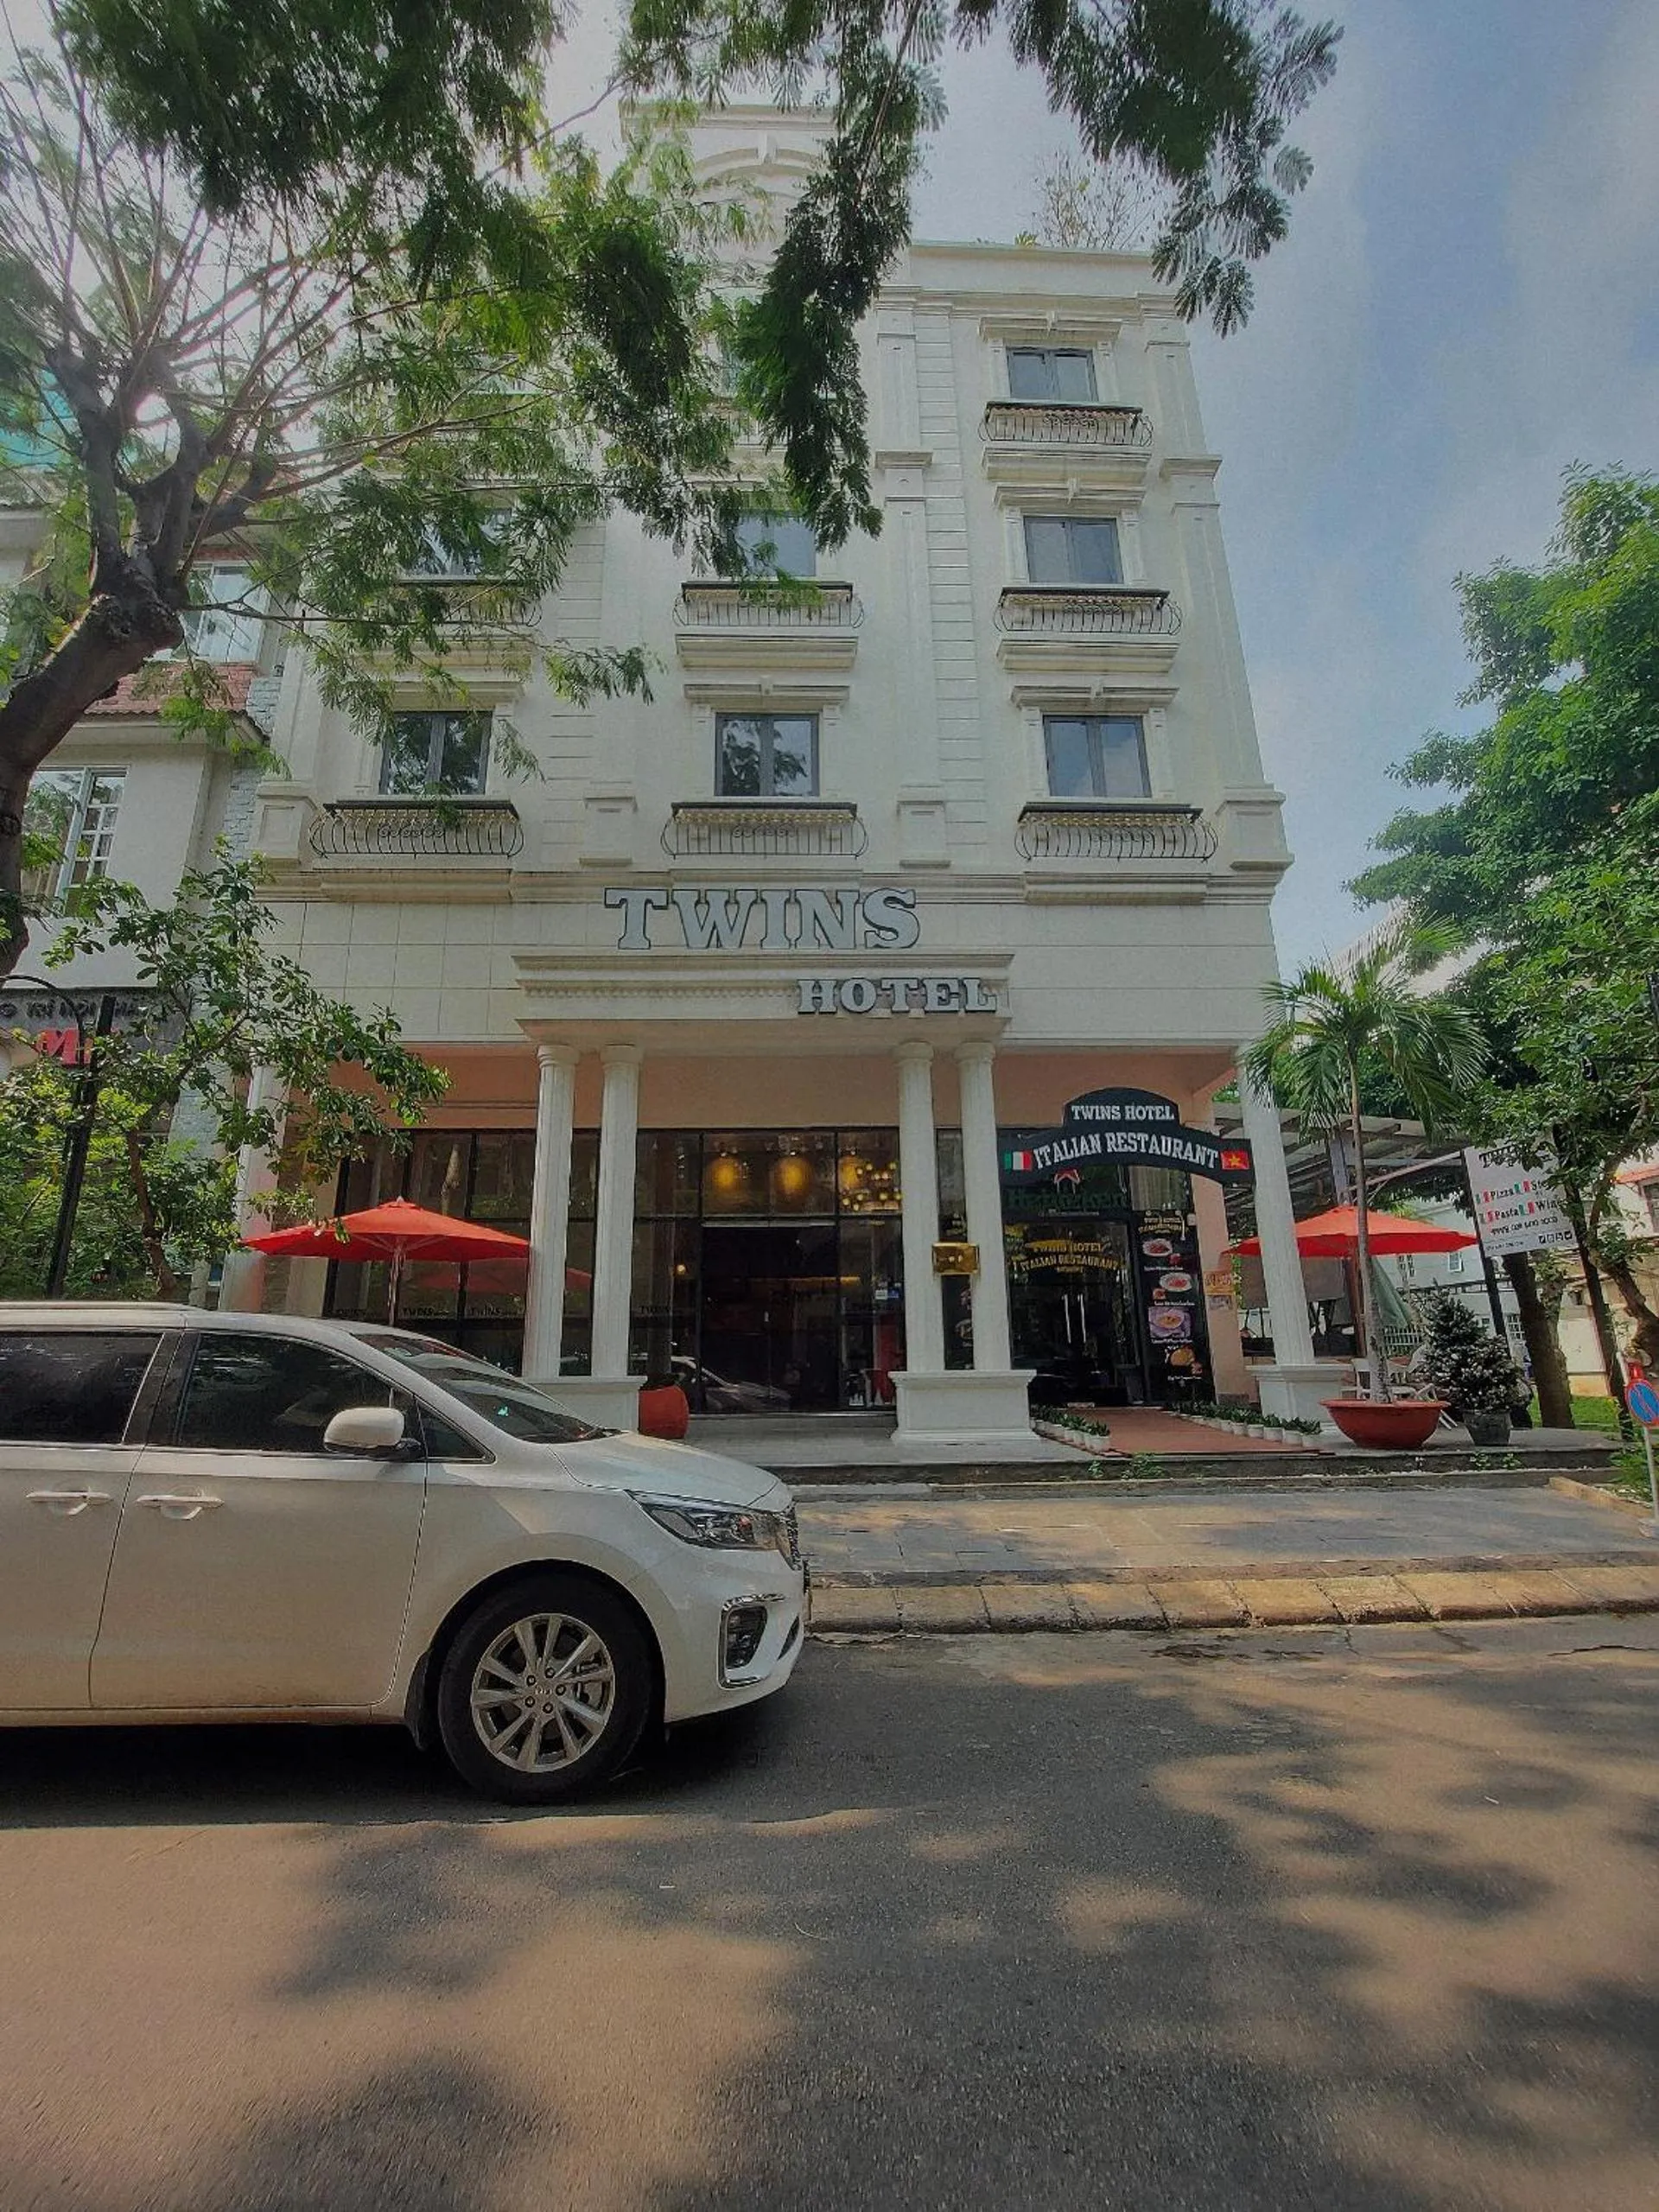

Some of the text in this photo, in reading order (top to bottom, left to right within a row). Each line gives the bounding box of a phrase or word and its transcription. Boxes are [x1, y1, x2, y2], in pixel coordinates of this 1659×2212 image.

[604, 887, 920, 950] TWINS
[797, 977, 997, 1014] HOTEL
[1071, 1105, 1175, 1121] TWINS HOTEL
[1033, 1131, 1219, 1170] ITALIAN RESTAURANT
[1491, 1188, 1514, 1200] Pizza
[1495, 1208, 1519, 1220] Pasta
